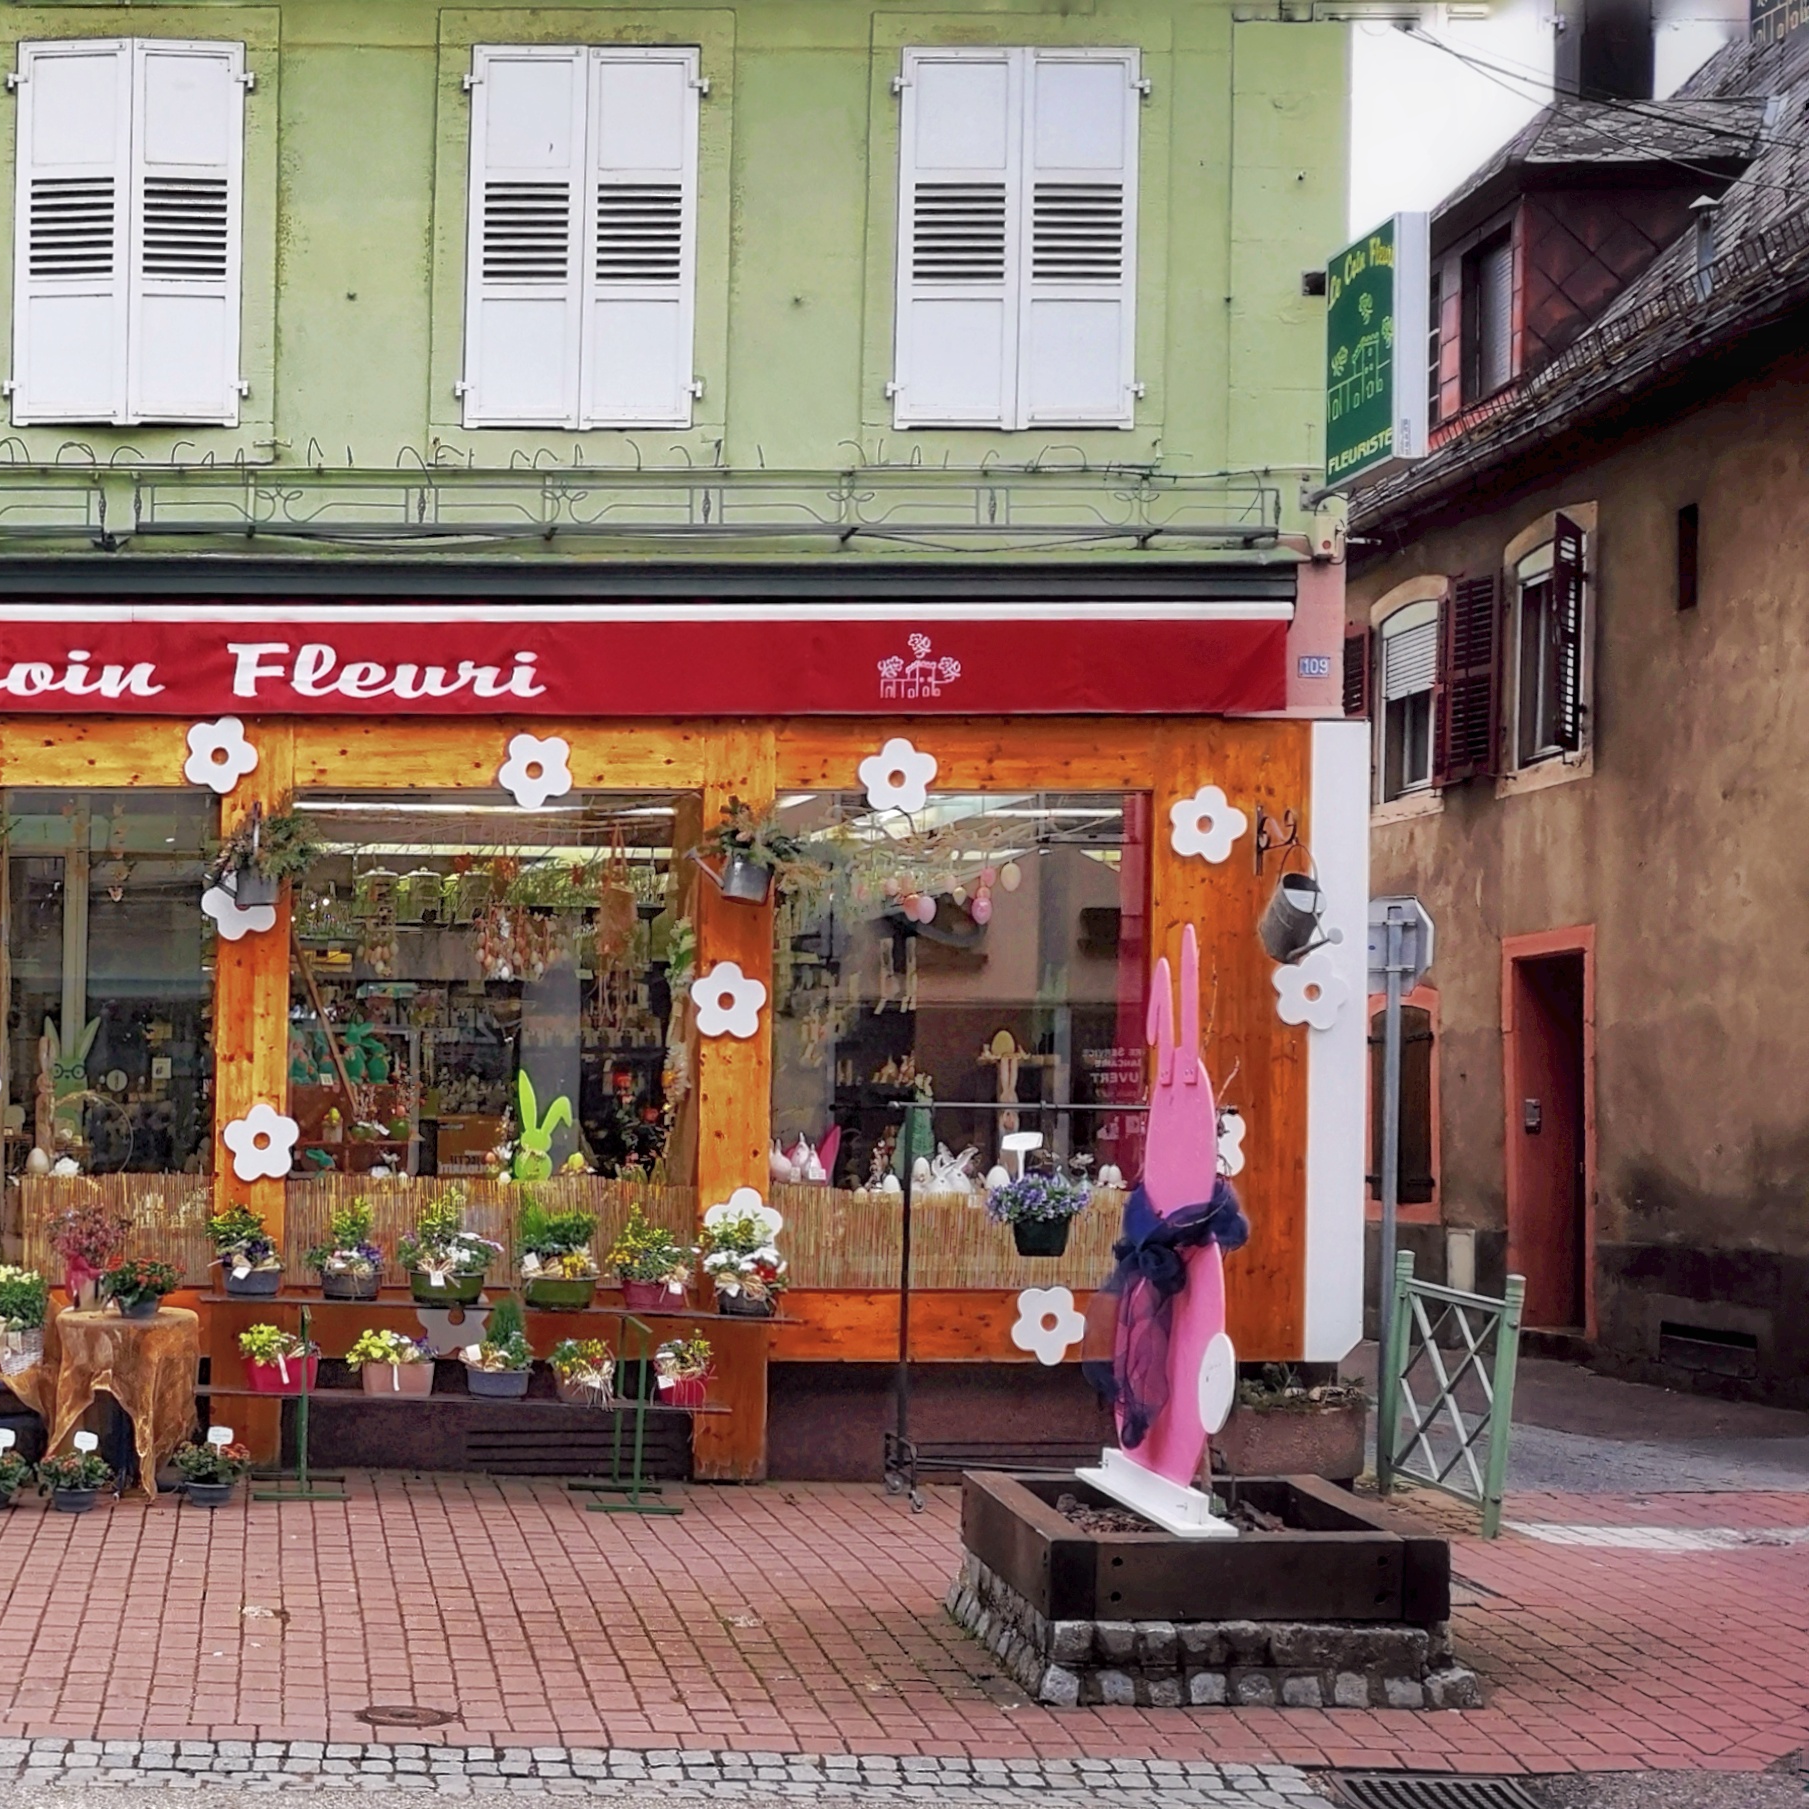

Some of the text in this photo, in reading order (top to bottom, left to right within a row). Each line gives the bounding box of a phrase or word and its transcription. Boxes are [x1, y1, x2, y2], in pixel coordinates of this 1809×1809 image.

[1329, 275, 1341, 311] Le
[1345, 251, 1366, 285] Coin
[1328, 427, 1393, 475] FLEURISTE
[226, 642, 545, 698] Fleuri
[1302, 658, 1328, 674] 109
